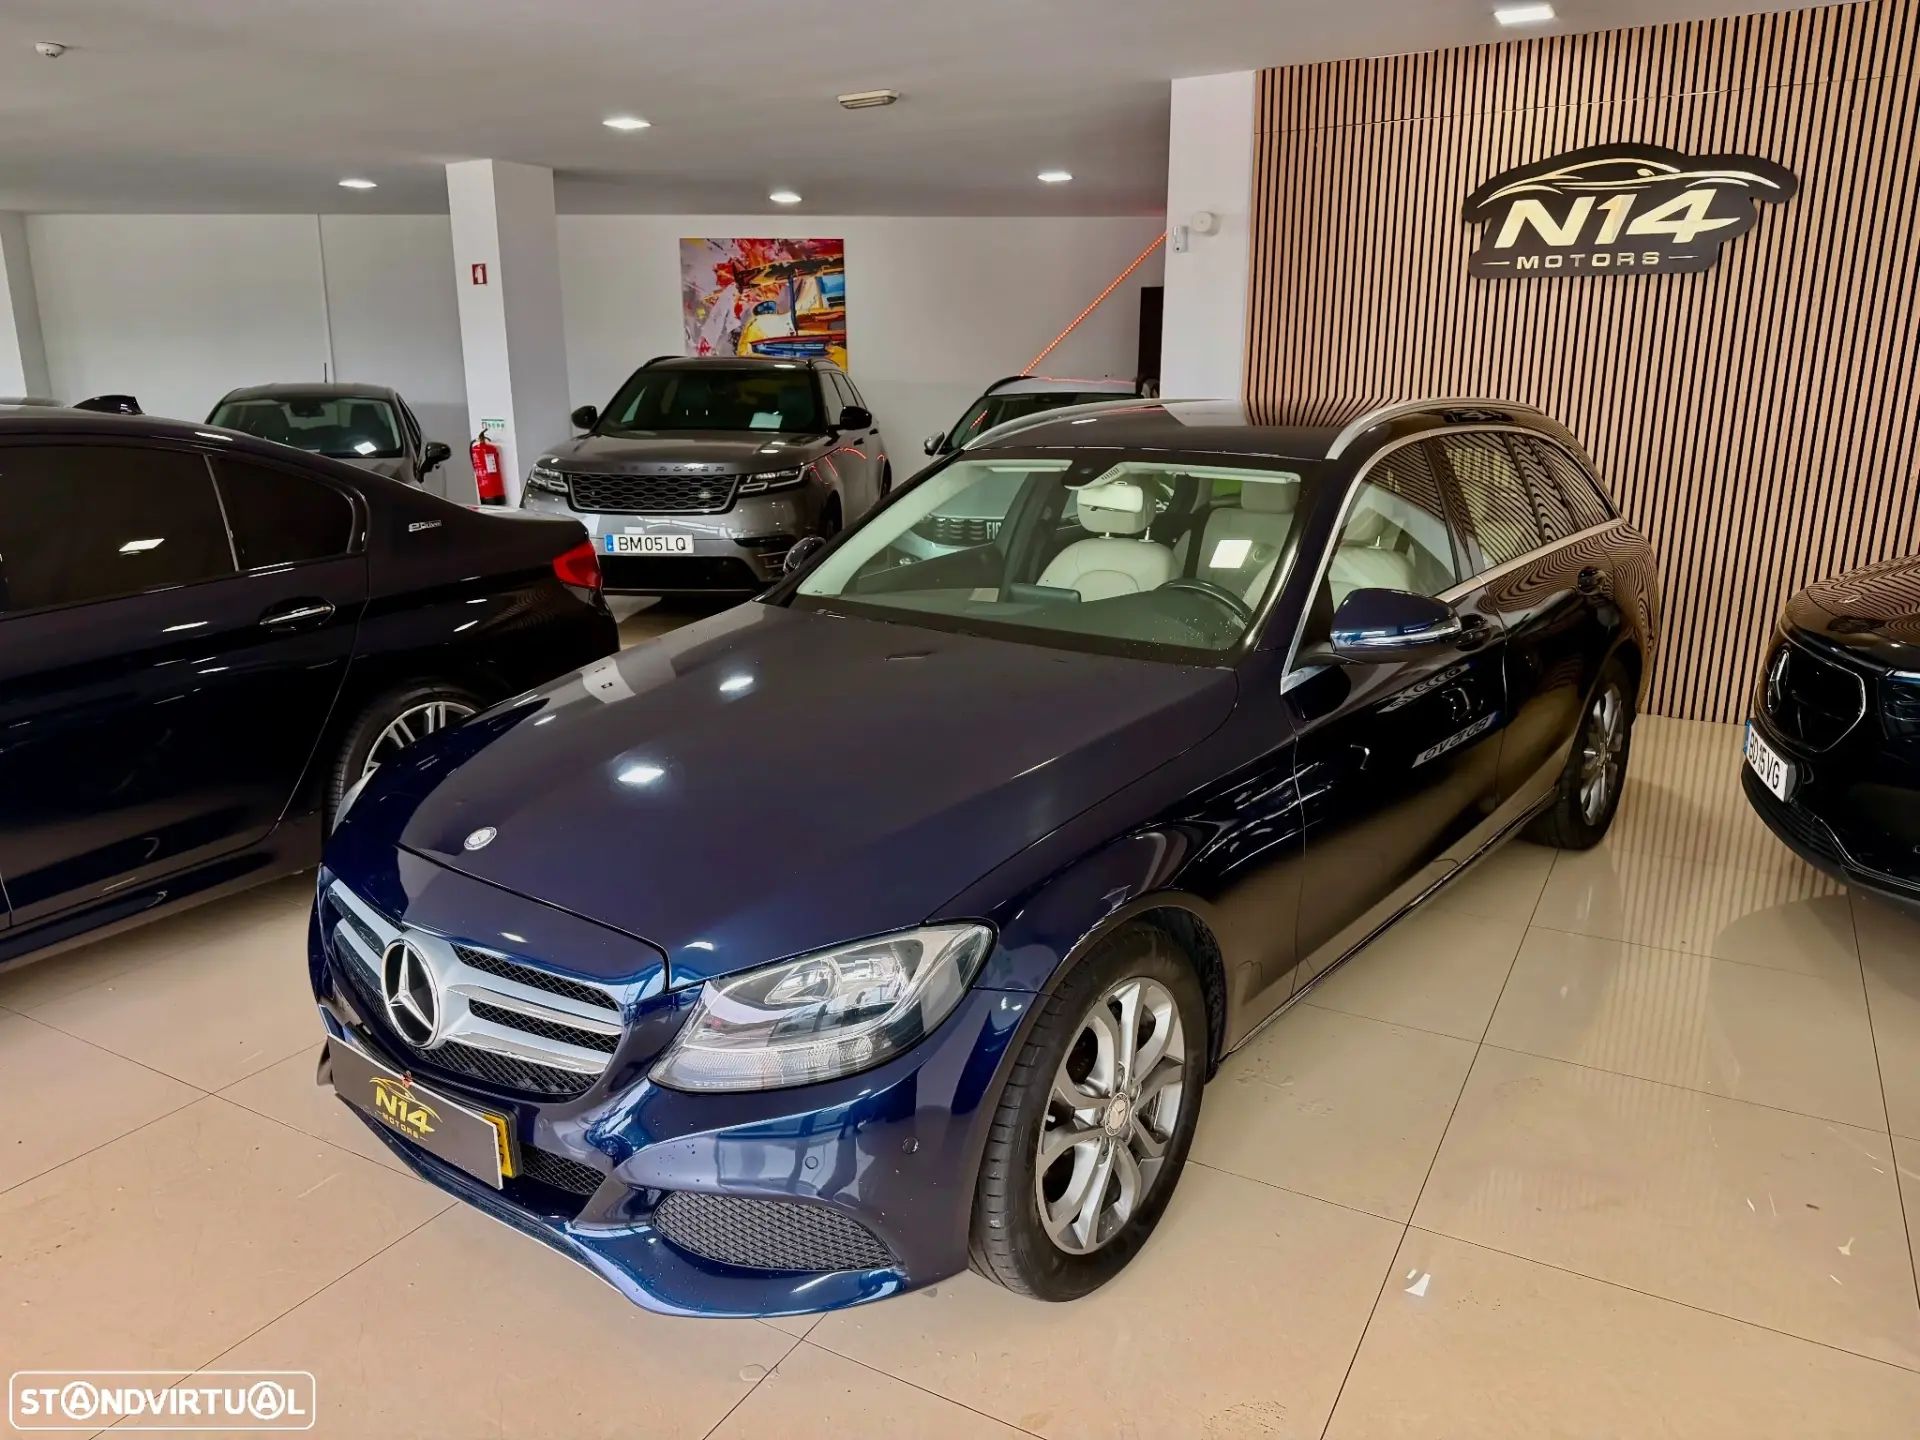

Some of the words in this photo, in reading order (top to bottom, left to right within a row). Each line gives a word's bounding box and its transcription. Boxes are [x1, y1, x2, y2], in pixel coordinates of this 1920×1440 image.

[1494, 189, 1741, 249] N14
[1516, 252, 1661, 270] MOTORS
[985, 521, 1002, 540] FI
[618, 536, 687, 552] BM05LQ
[375, 1086, 436, 1134] N14
[382, 1112, 419, 1139] MOTORS
